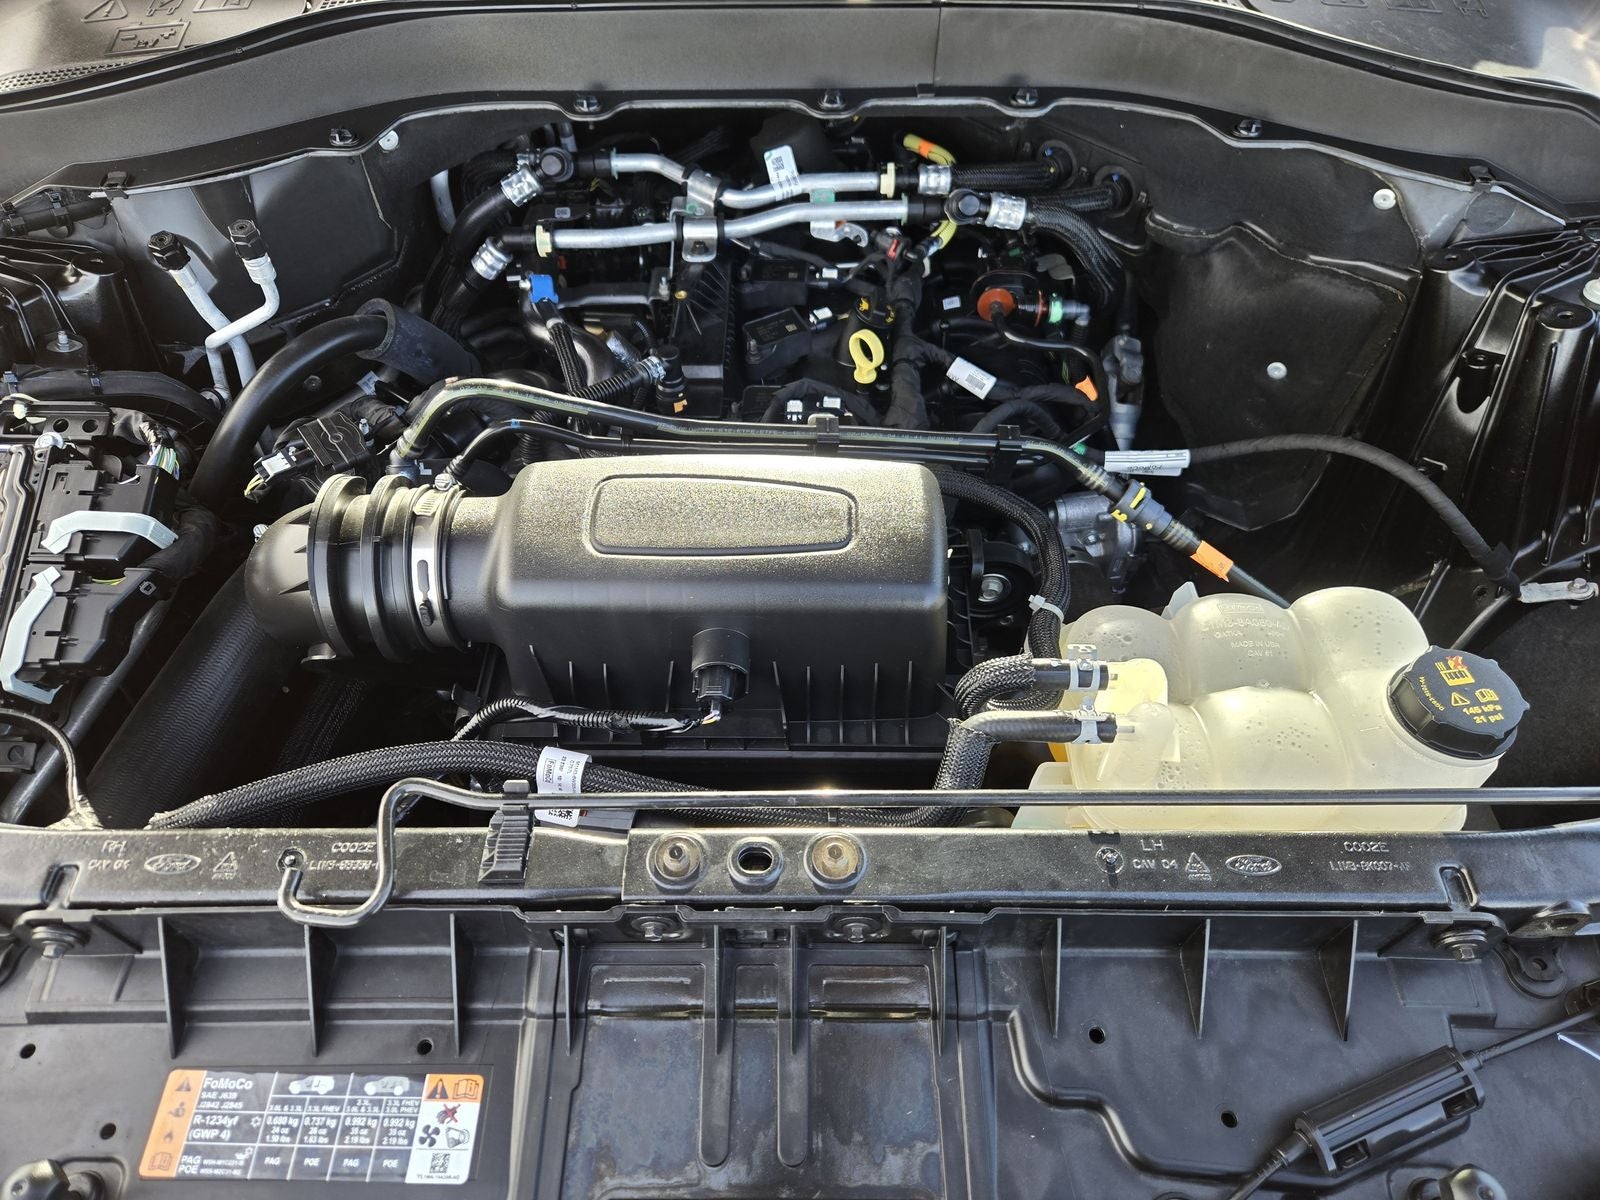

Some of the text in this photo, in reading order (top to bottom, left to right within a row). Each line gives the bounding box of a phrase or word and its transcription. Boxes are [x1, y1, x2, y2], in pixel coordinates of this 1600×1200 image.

[1231, 640, 1253, 649] MADE
[1265, 640, 1280, 649] USA
[1462, 703, 1503, 716] 145 kPa
[1473, 713, 1505, 724] 21 psi
[1140, 839, 1165, 851] LH
[1132, 858, 1156, 870] CAV
[203, 1077, 254, 1090] FoMoCo
[201, 1091, 218, 1099] SAE
[192, 1114, 240, 1128] R-1234yf
[288, 1116, 300, 1128] kg
[304, 1116, 338, 1129] 0.737 kg
[344, 1116, 378, 1128] 0.992 kg
[382, 1117, 416, 1130] 0.992 kg
[189, 1128, 232, 1141] (GWP 4)
[180, 1155, 202, 1165] PAG
[264, 1156, 281, 1166] PAG
[304, 1157, 320, 1167] POE
[343, 1158, 360, 1168] PAG
[382, 1159, 399, 1168] POE
[178, 1164, 200, 1174] POE
